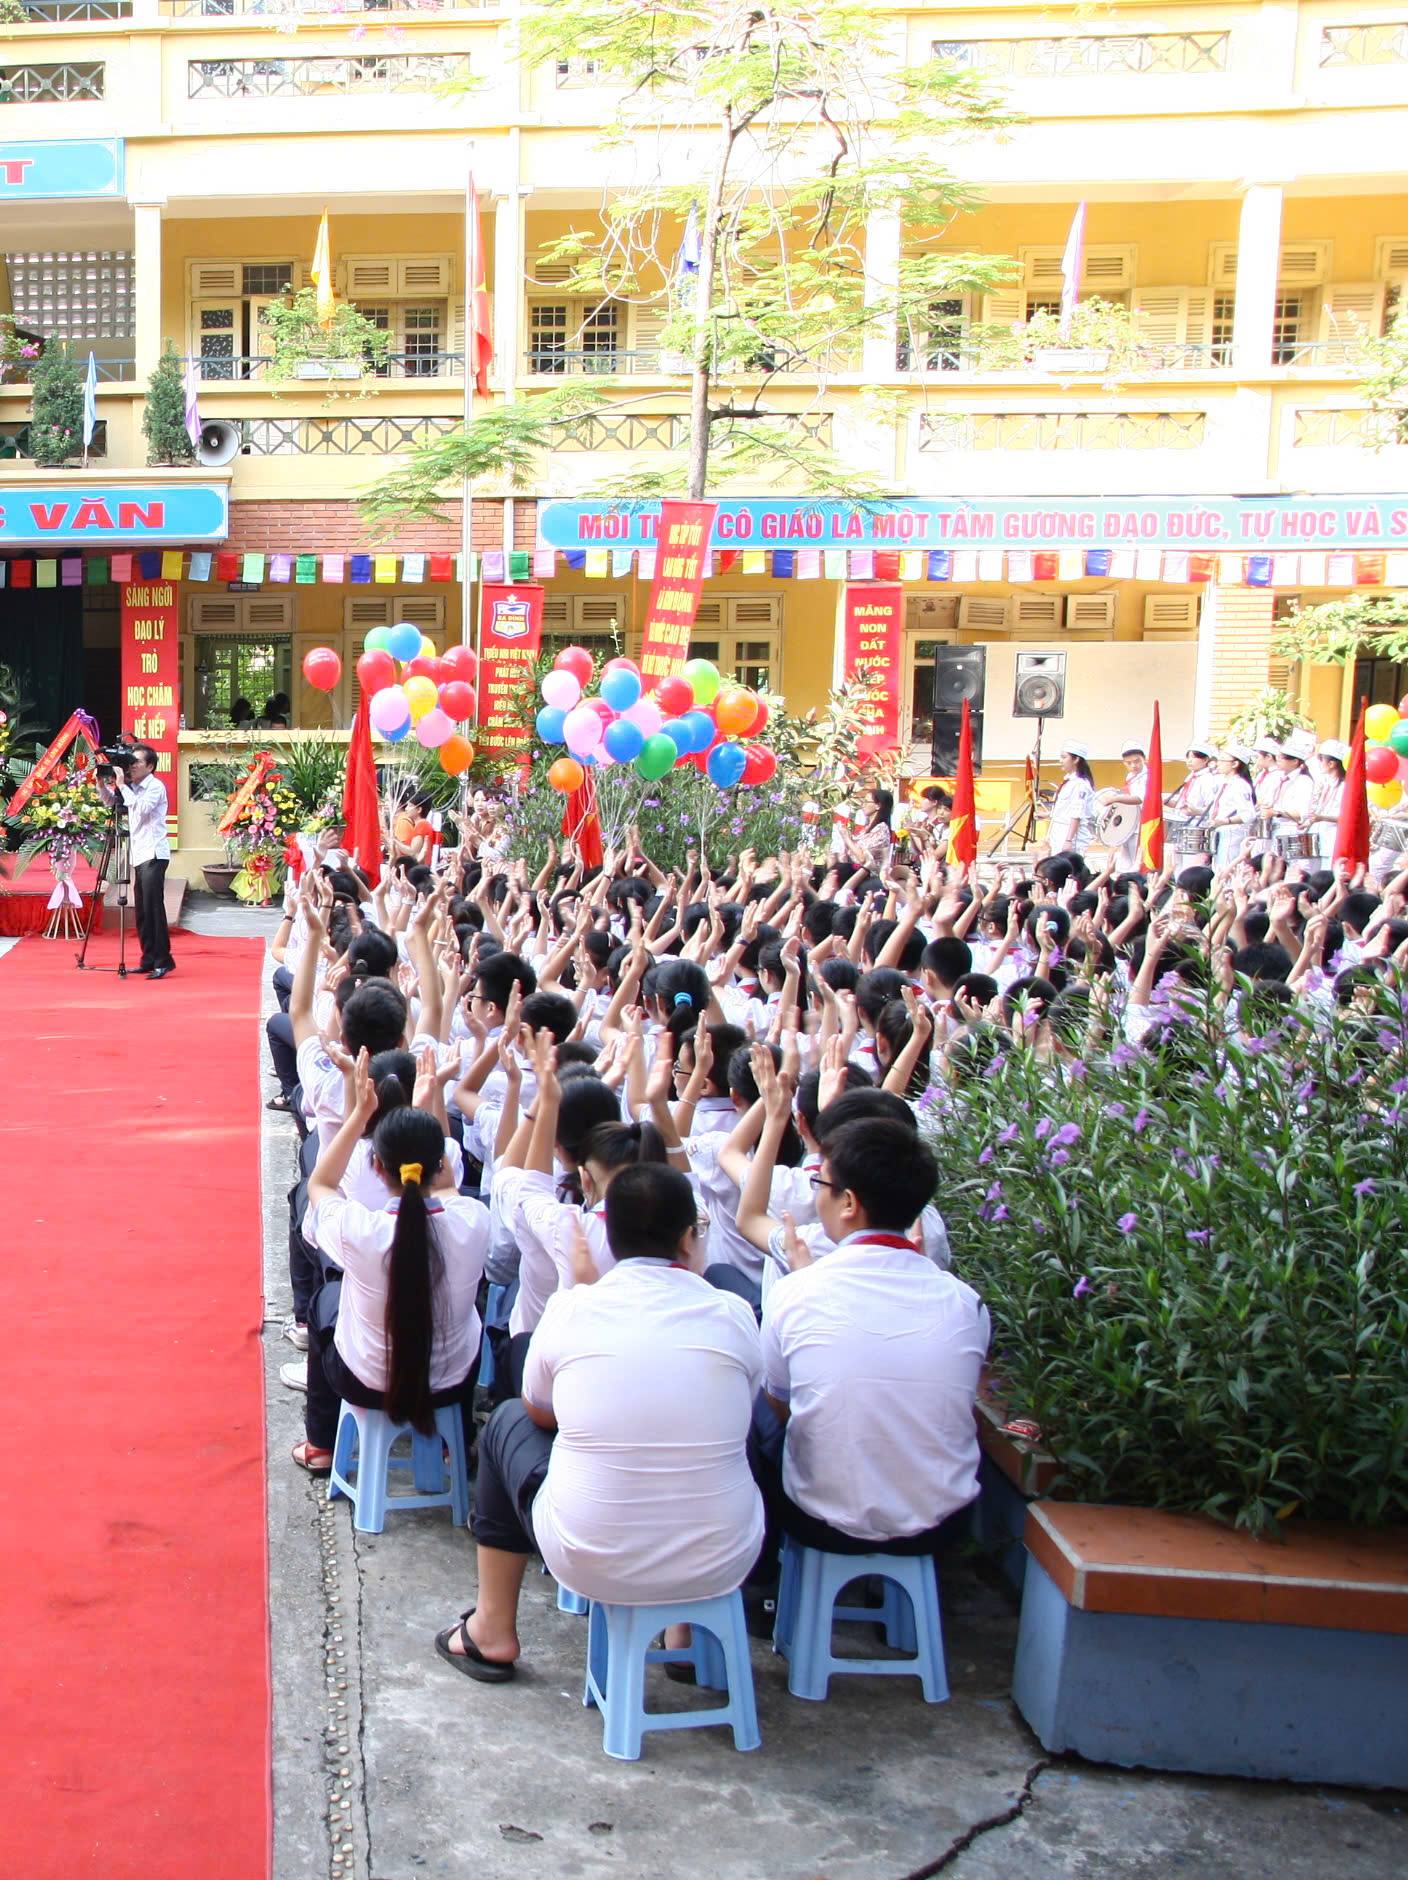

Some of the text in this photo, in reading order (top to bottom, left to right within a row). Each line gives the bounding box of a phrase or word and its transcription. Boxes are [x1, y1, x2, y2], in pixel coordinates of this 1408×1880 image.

[28, 497, 165, 530] VĂN
[718, 508, 752, 538] CÔ
[761, 507, 824, 538] GIÁO
[872, 508, 930, 544] MỘT
[938, 504, 994, 538] TẤM
[1003, 510, 1095, 538] GƯƠNG
[1104, 512, 1158, 543] ĐẠO
[1167, 505, 1230, 541] ĐỨC,
[1239, 510, 1276, 542] TỰ
[1280, 511, 1336, 542] HỌC
[1346, 506, 1381, 537] VÀ
[126, 581, 173, 608] SÁNG NGỜI
[853, 604, 893, 617] MĂNG
[134, 616, 165, 644] ĐẠO LÝ
[859, 623, 887, 633] NON
[860, 637, 886, 650] ĐẤT
[141, 648, 158, 674] TRÒ
[127, 682, 173, 711] HỌC CHĂM
[148, 712, 166, 739] NẾP
